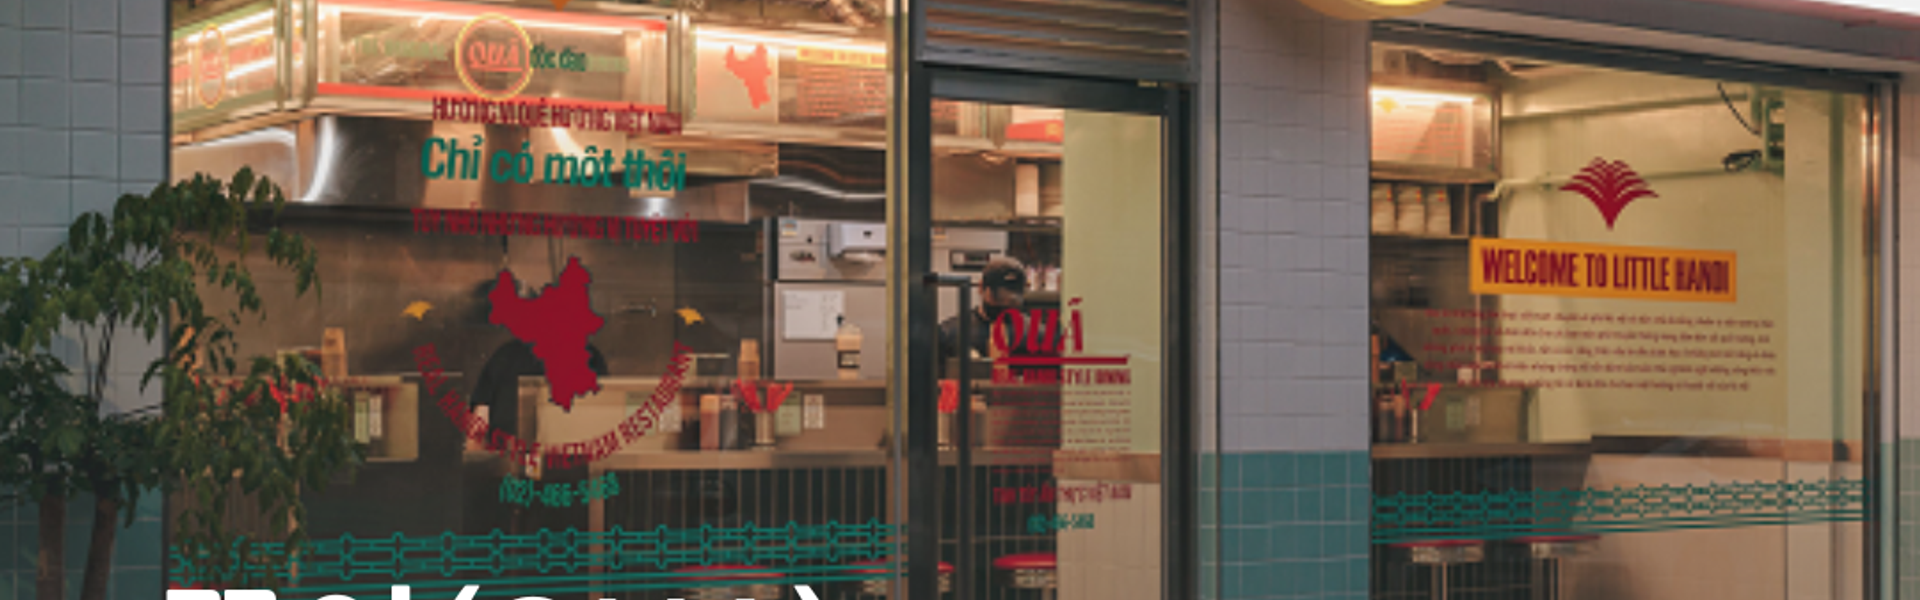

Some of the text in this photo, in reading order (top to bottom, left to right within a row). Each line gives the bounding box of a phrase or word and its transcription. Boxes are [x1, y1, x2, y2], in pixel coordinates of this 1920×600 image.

[421, 134, 485, 180] Chỉ
[489, 141, 534, 184] có
[621, 148, 687, 191] thôi
[1480, 246, 1730, 295] WELCOME TO LITTLE HANOI
